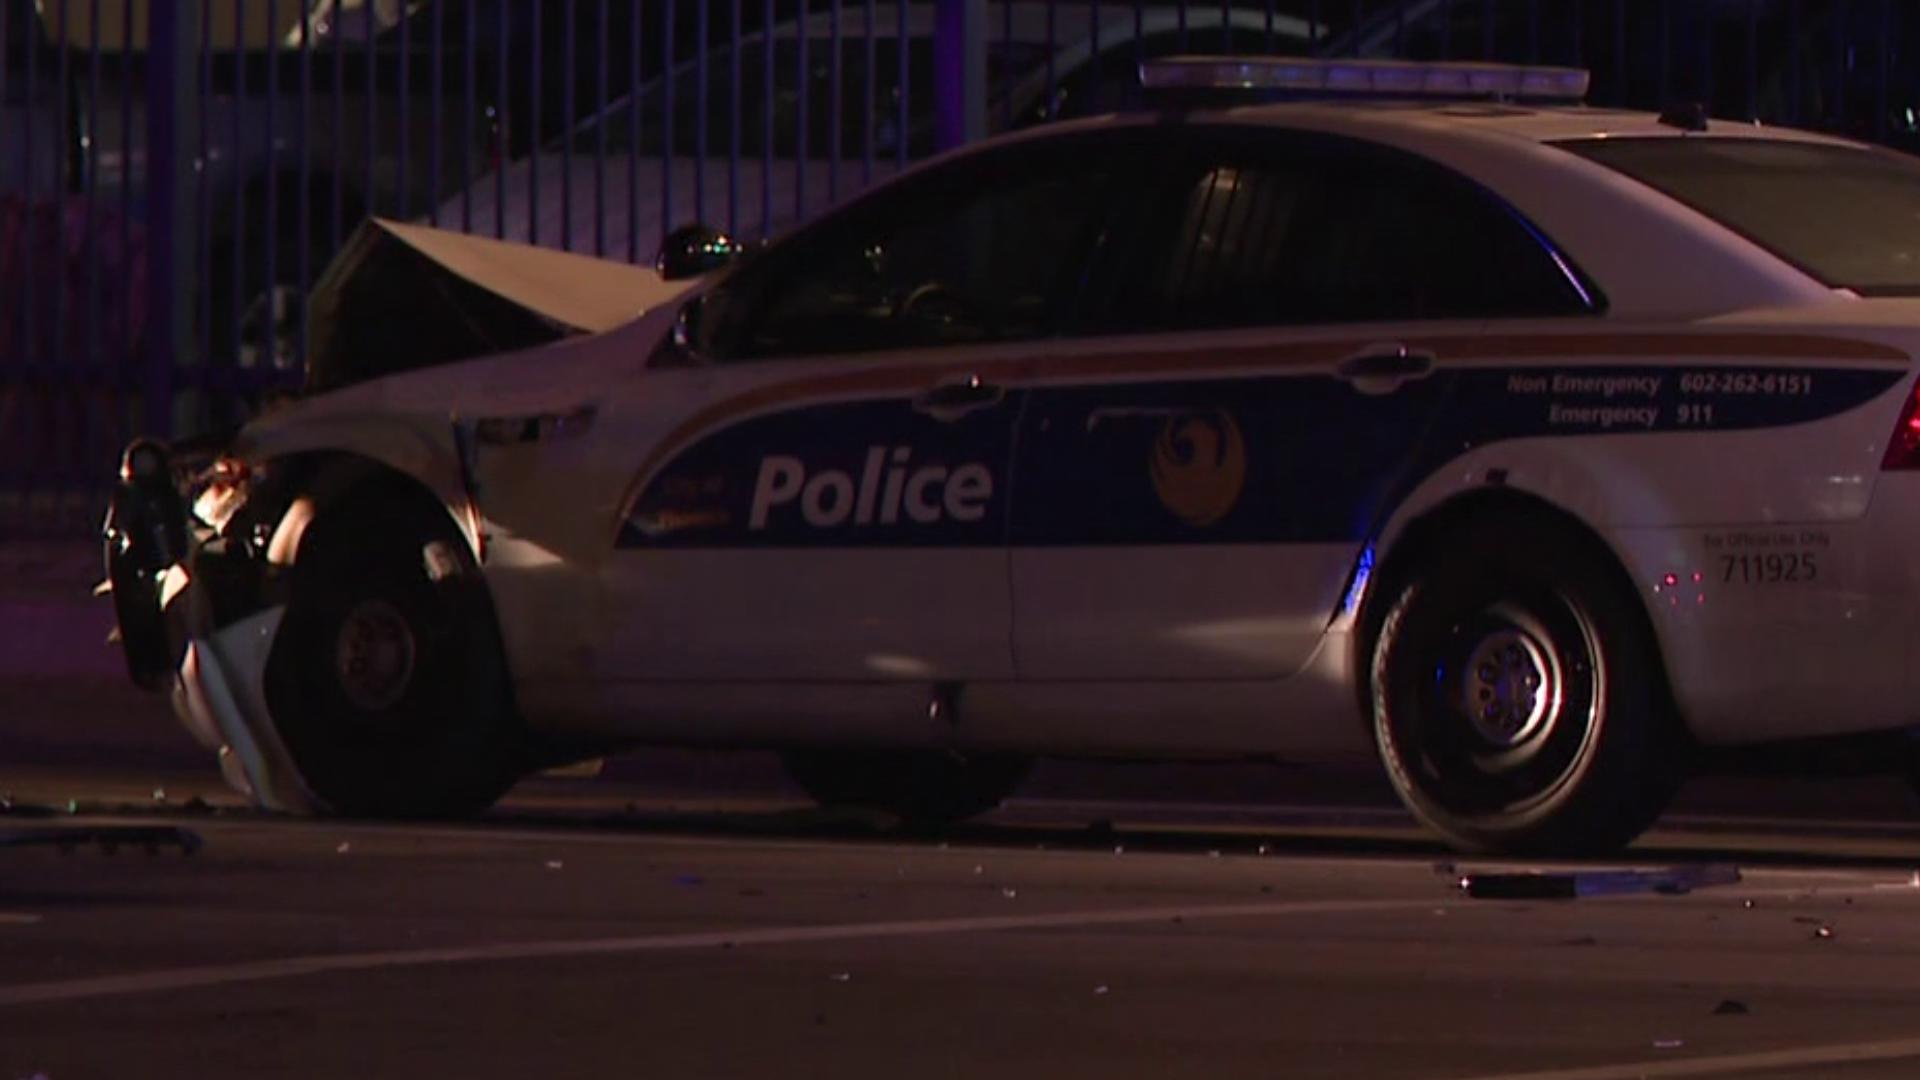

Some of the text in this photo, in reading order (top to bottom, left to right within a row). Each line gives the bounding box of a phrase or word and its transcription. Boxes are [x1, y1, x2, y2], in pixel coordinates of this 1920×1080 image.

[1506, 373, 1661, 396] Non Emergency
[1680, 372, 1812, 395] 602-262-6151
[1549, 402, 1658, 426] Emergency
[1677, 403, 1713, 423] 911
[749, 446, 993, 530] Police
[1720, 552, 1817, 583] 711925
